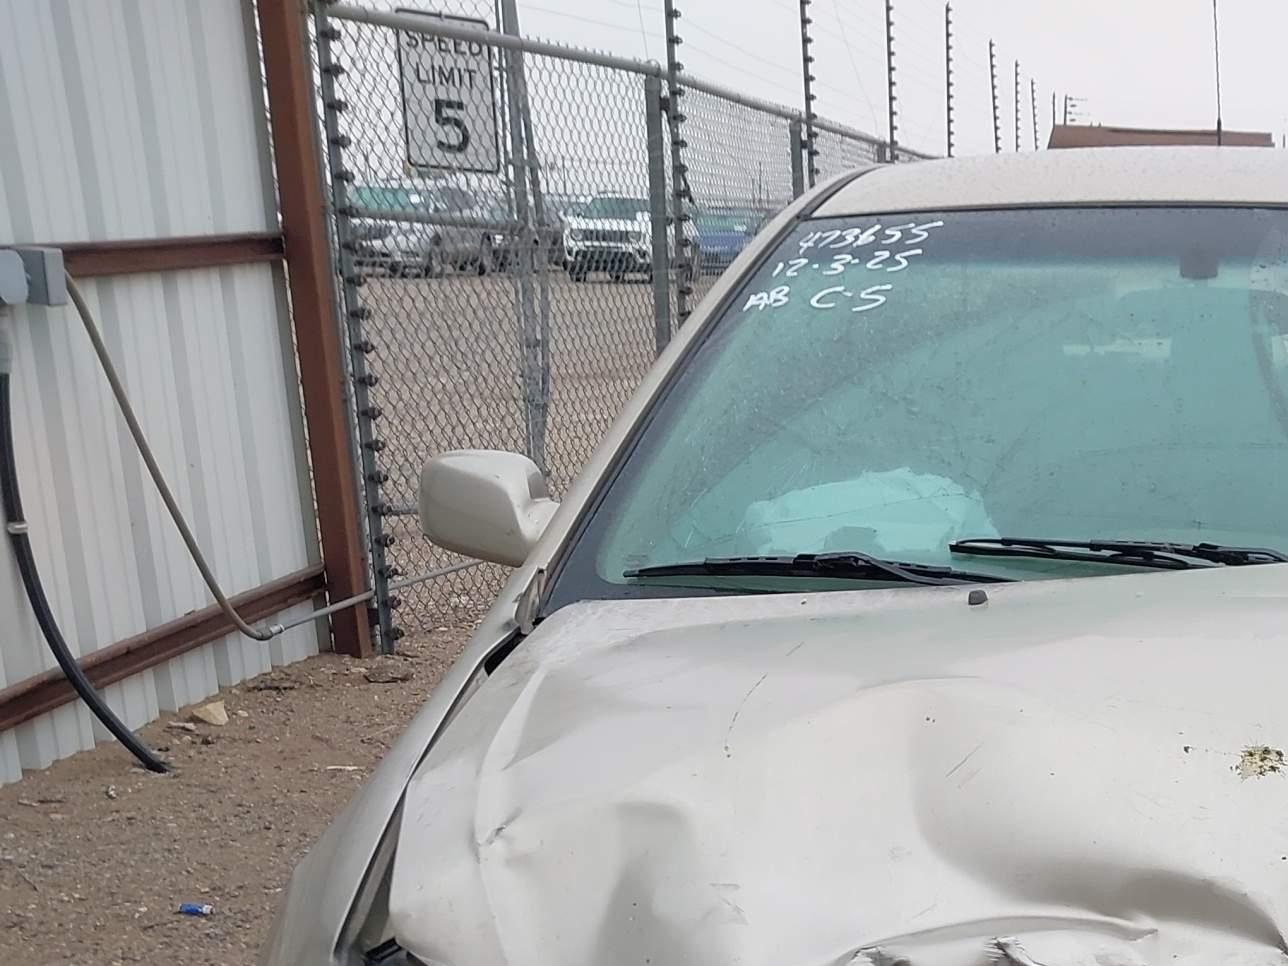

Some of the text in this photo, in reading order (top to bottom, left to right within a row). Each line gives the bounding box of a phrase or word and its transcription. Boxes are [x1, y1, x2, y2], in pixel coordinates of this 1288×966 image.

[405, 29, 482, 56] SPEED
[415, 62, 477, 89] LIMIT
[434, 98, 470, 153] 5
